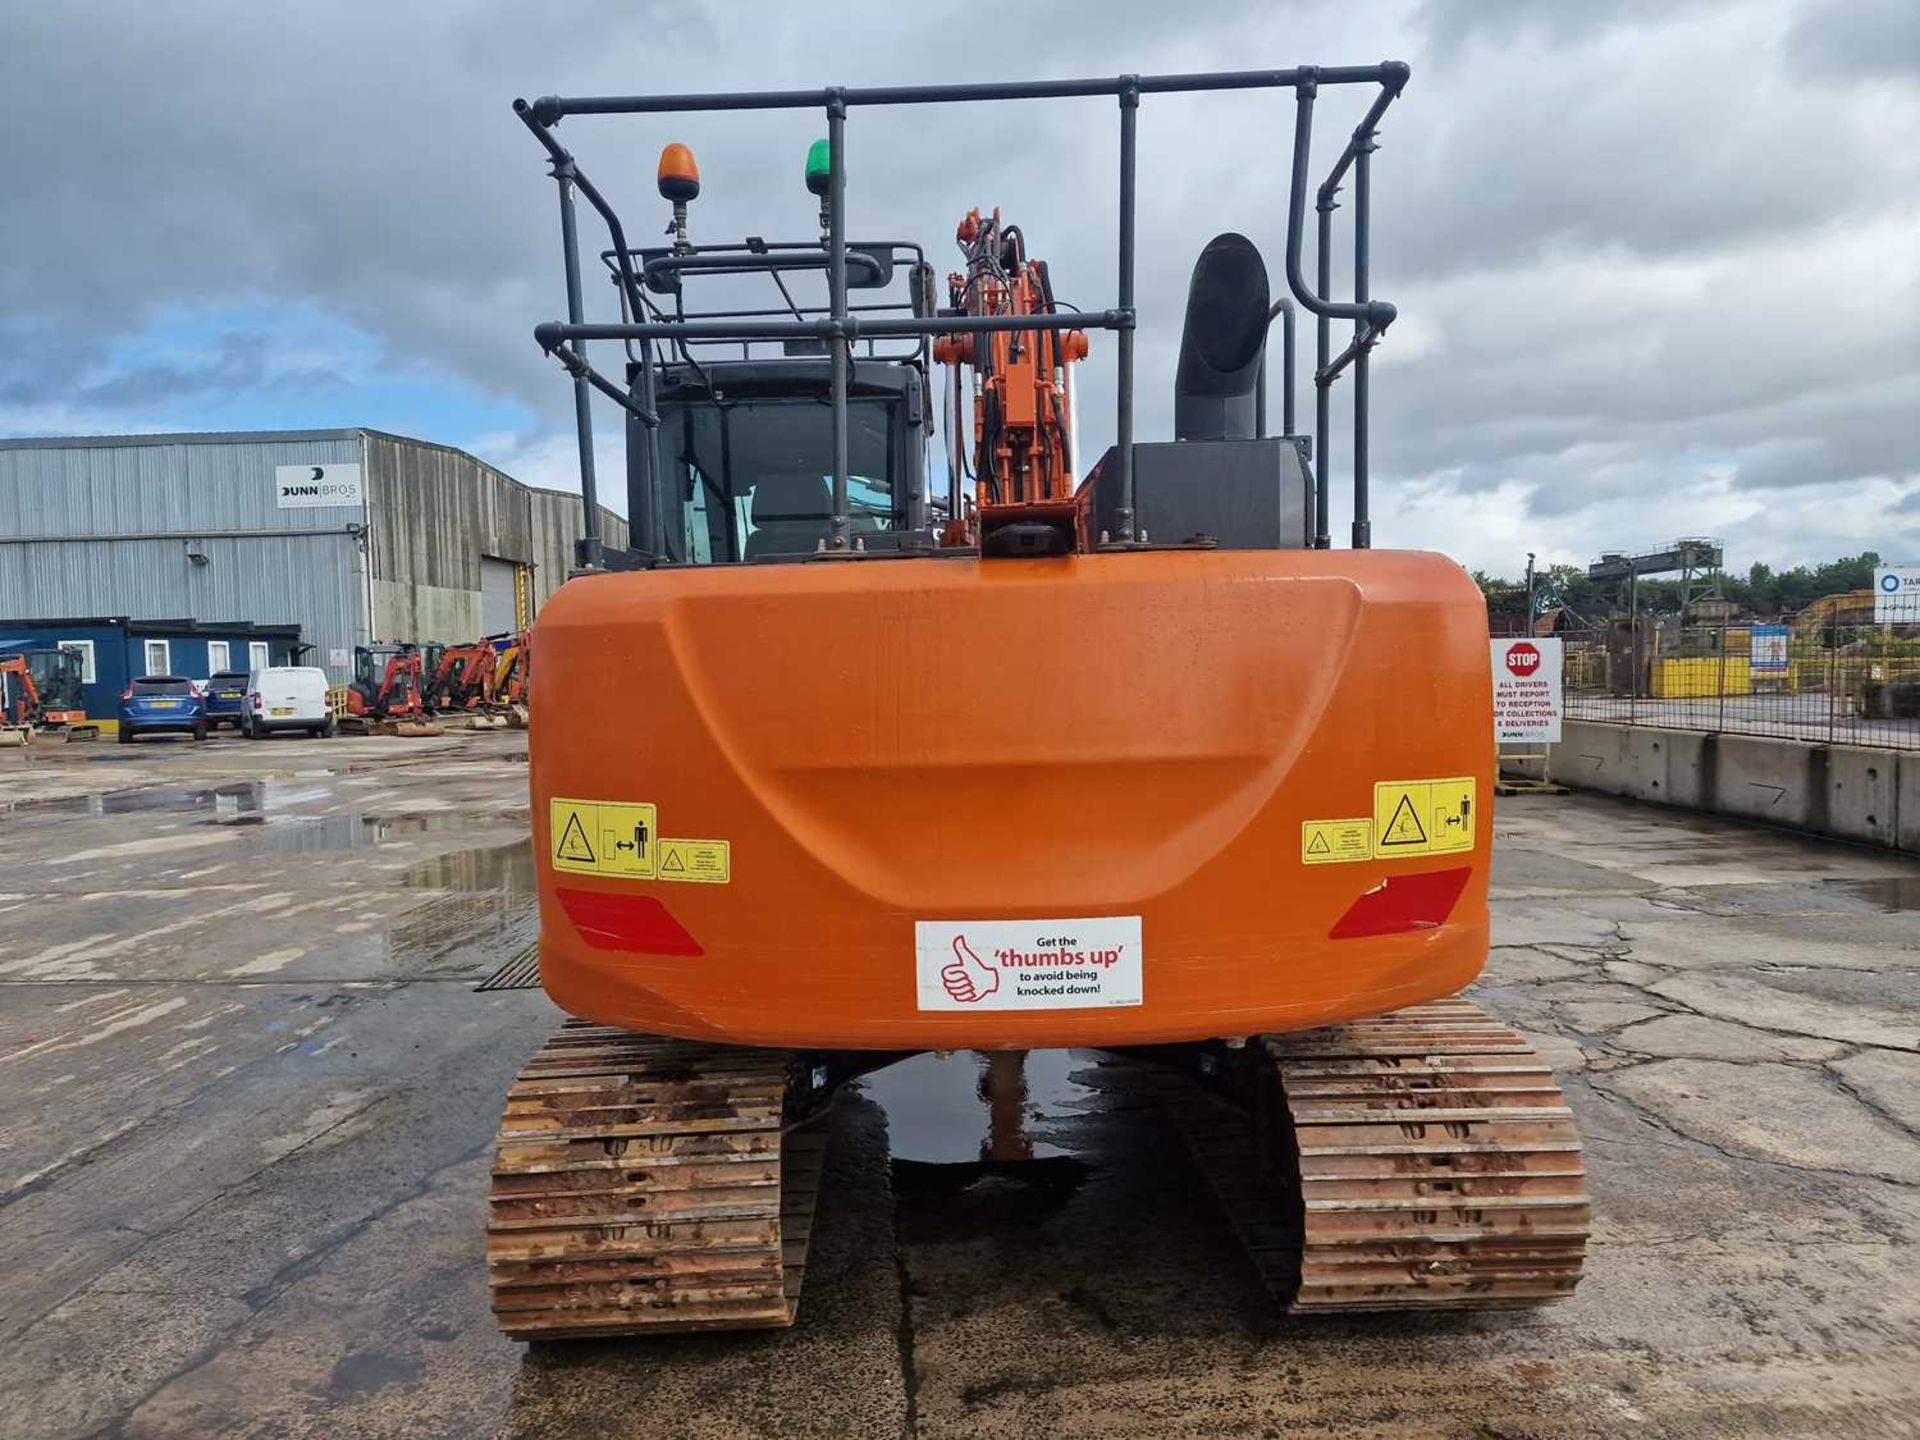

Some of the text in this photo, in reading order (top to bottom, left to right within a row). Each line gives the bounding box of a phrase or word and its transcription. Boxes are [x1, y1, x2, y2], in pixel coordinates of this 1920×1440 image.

[282, 484, 356, 496] DUNN BROS
[1508, 653, 1538, 666] STOP
[1037, 937, 1077, 947] Get the
[1020, 970, 1098, 982] to avoid being
[1017, 984, 1101, 996] knocked down!
